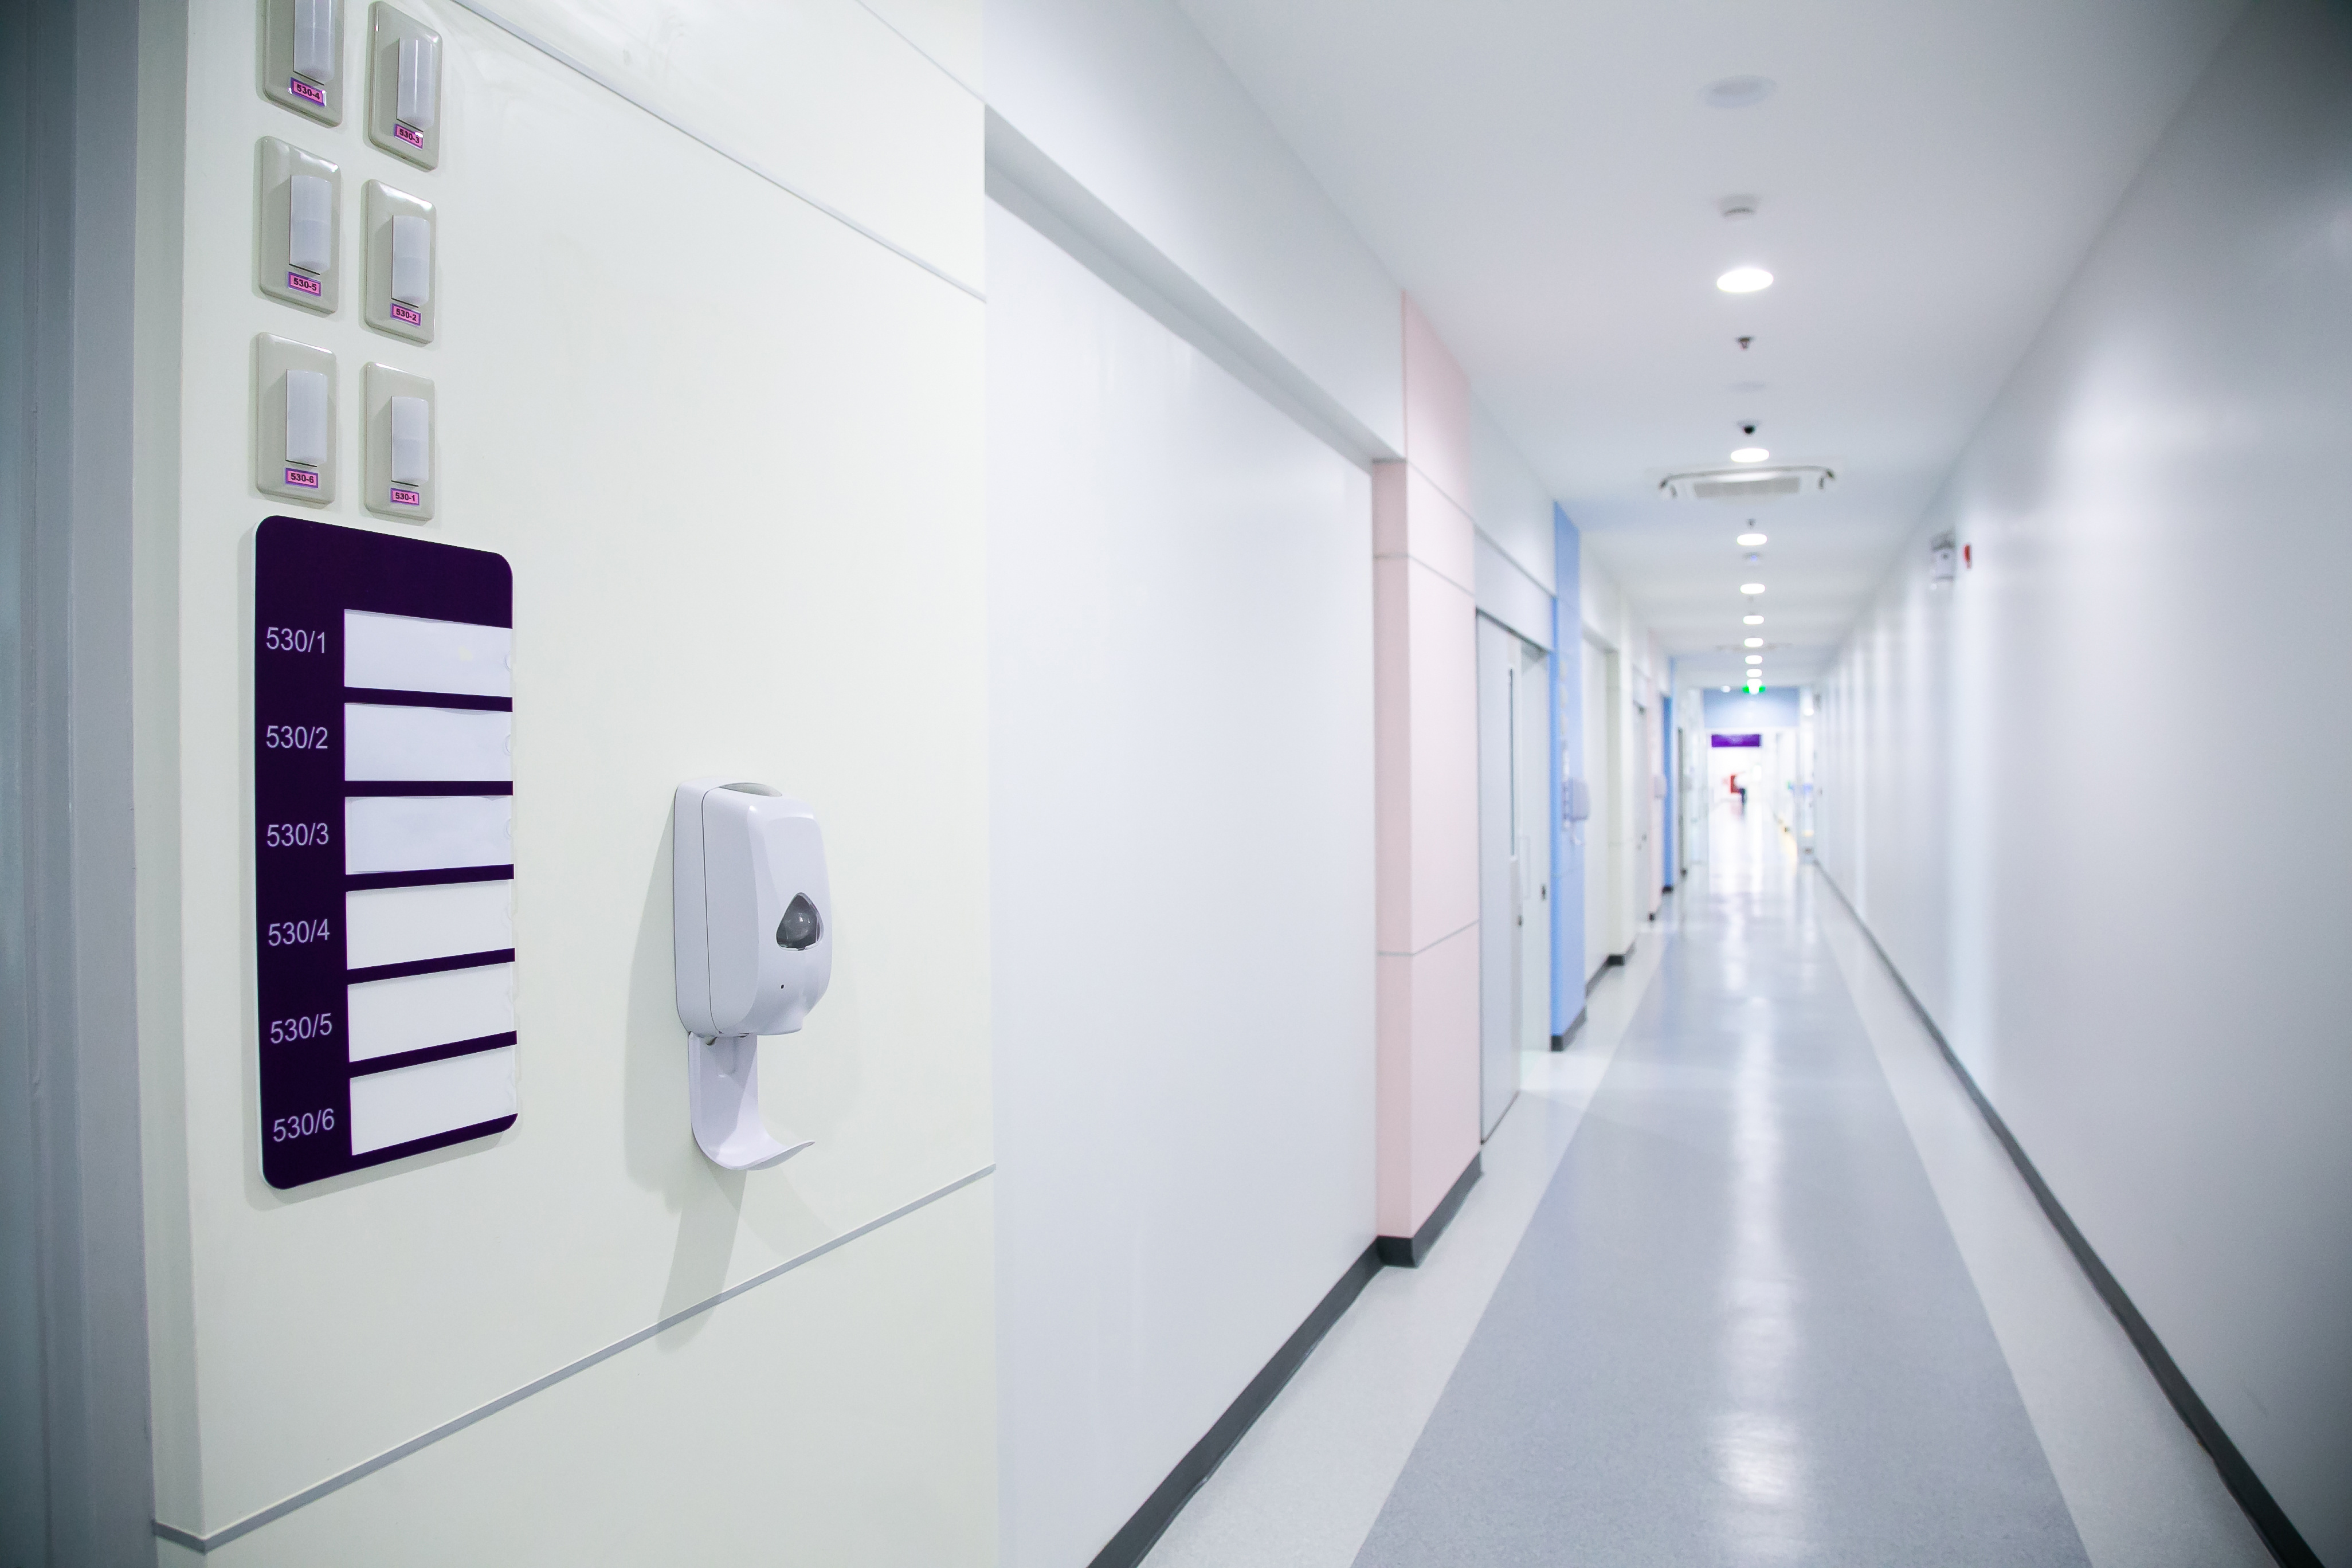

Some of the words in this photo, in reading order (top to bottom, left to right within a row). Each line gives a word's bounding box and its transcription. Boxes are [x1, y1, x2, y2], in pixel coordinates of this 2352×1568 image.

[296, 84, 320, 100] 530-4
[399, 128, 420, 144] 530-3
[293, 277, 317, 291] 530-5
[396, 308, 417, 321] 530-2
[291, 472, 314, 483] 530-6
[395, 492, 415, 501] 530-1
[266, 627, 326, 653] 530/1
[266, 725, 328, 749] 530/2
[266, 822, 329, 847] 530/3
[268, 919, 330, 946] 530/4
[270, 1013, 332, 1044] 530/5
[273, 1108, 335, 1142] 530/6
